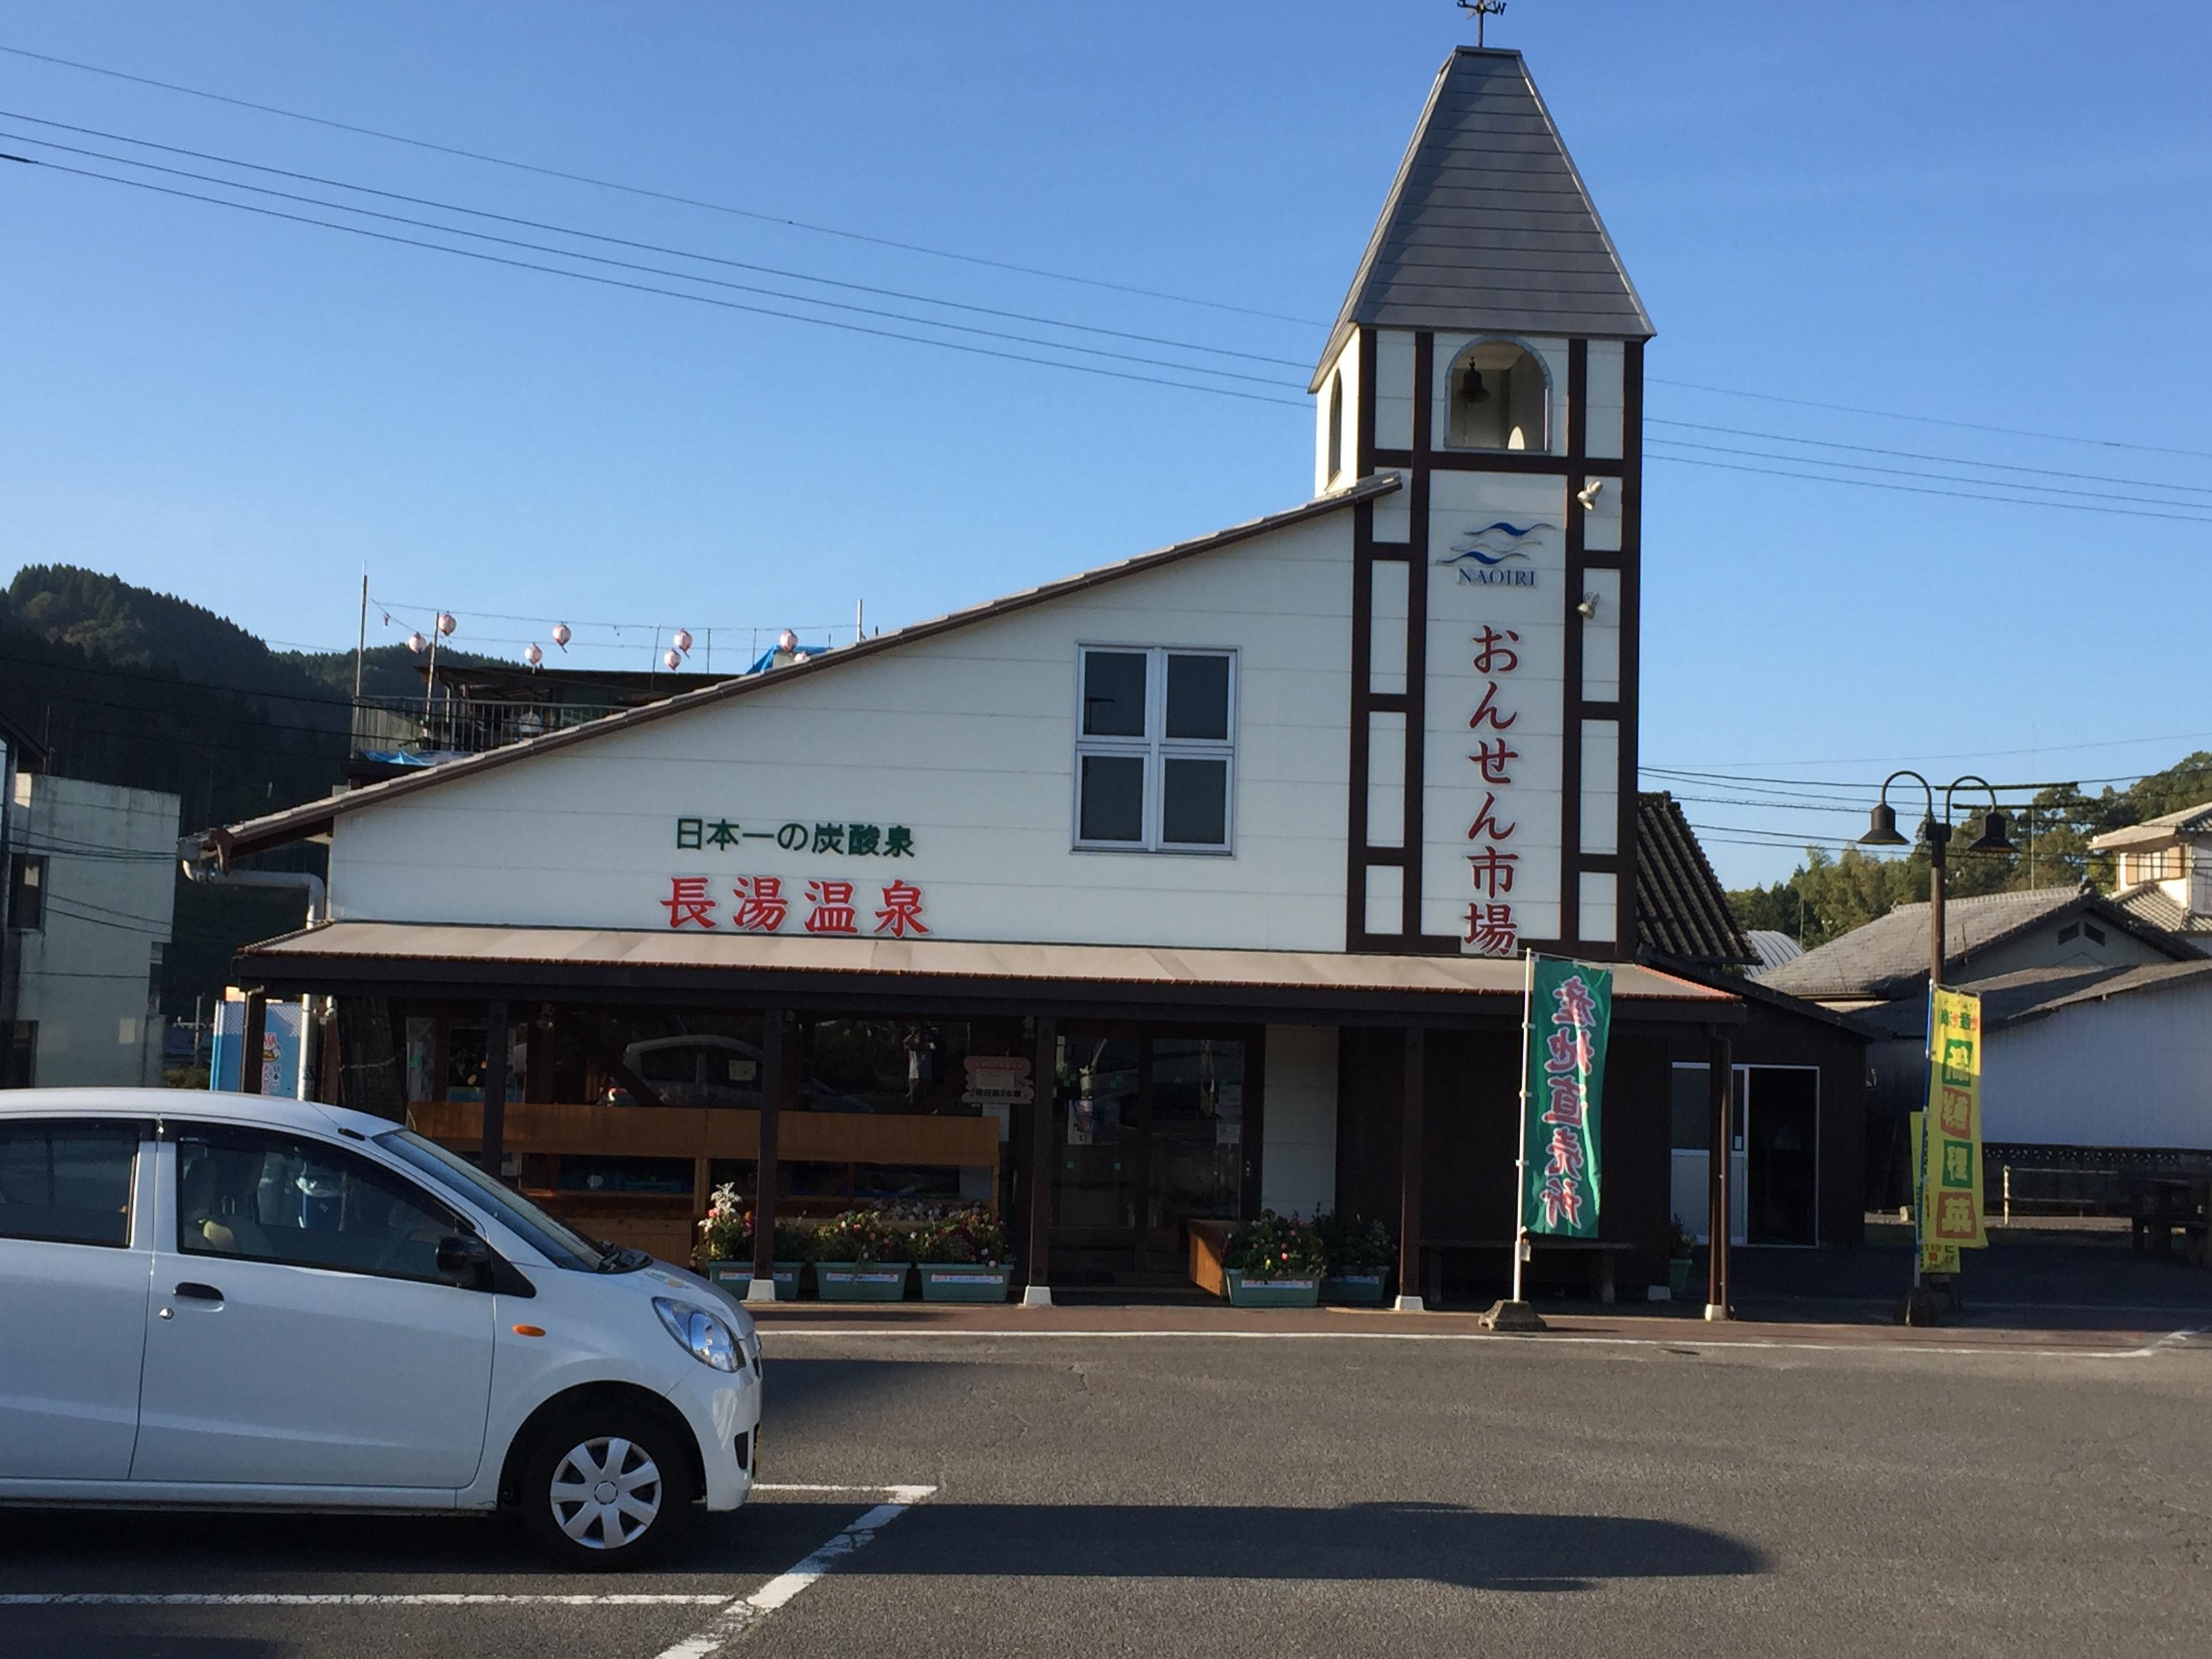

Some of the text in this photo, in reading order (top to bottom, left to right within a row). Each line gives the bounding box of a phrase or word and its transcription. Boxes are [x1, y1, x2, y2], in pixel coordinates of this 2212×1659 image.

[1458, 568, 1535, 587] NAOIRI
[1463, 625, 1519, 956] おんせん市場
[676, 817, 915, 858] 日本一の炭酸泉
[659, 875, 930, 939] 長湯温泉
